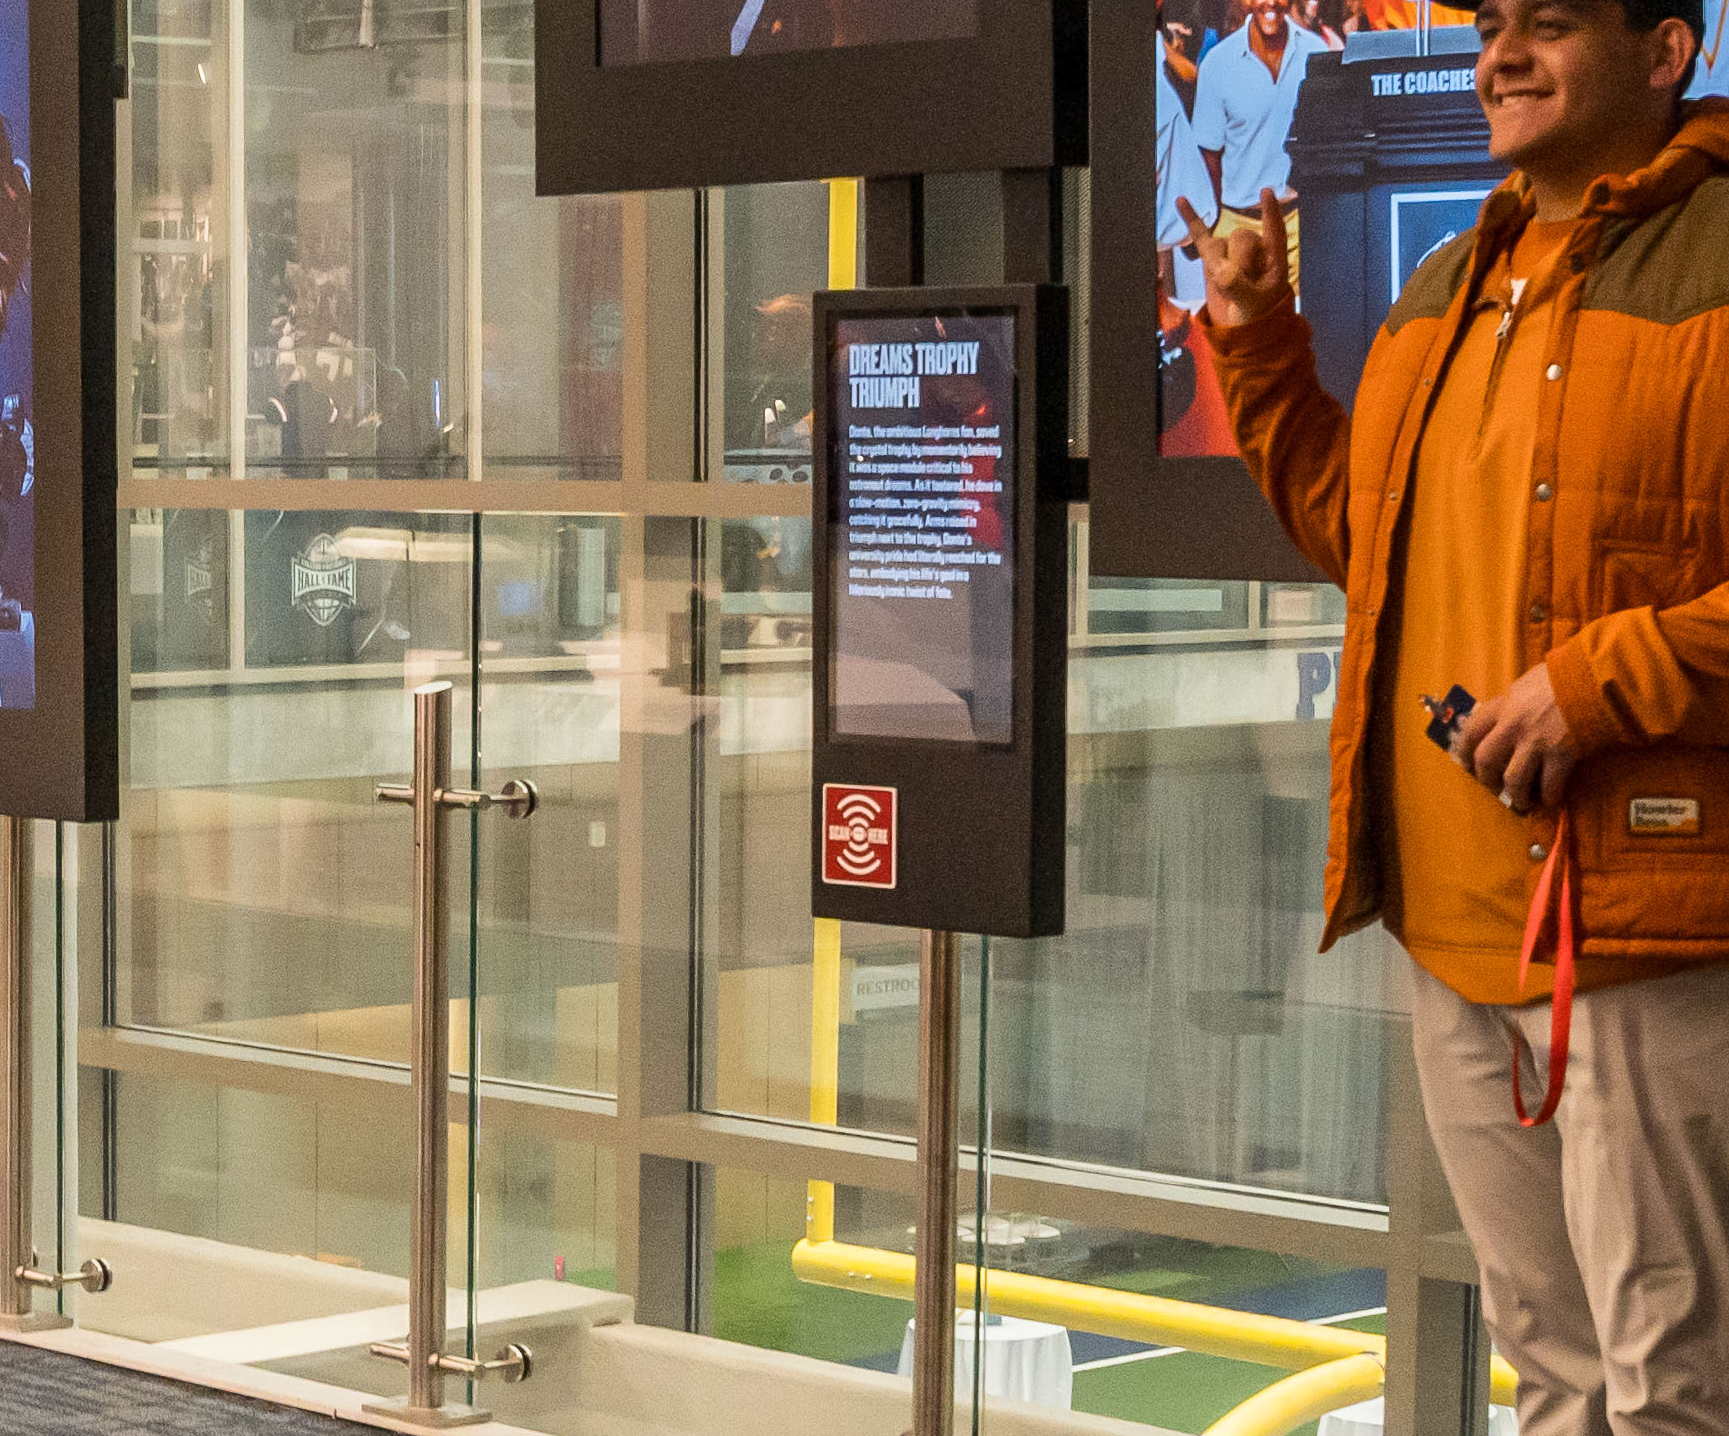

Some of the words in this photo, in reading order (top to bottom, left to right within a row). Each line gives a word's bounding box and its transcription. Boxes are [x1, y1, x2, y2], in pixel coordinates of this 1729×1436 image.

[1370, 73, 1402, 97] THE
[849, 343, 914, 376] DREAMS
[915, 341, 980, 375] TROPHY
[849, 376, 920, 409] TRIUMPH
[297, 567, 320, 594] HALL
[327, 567, 350, 594] FAME
[1295, 652, 1342, 722] P
[856, 977, 920, 996] RESTROO
